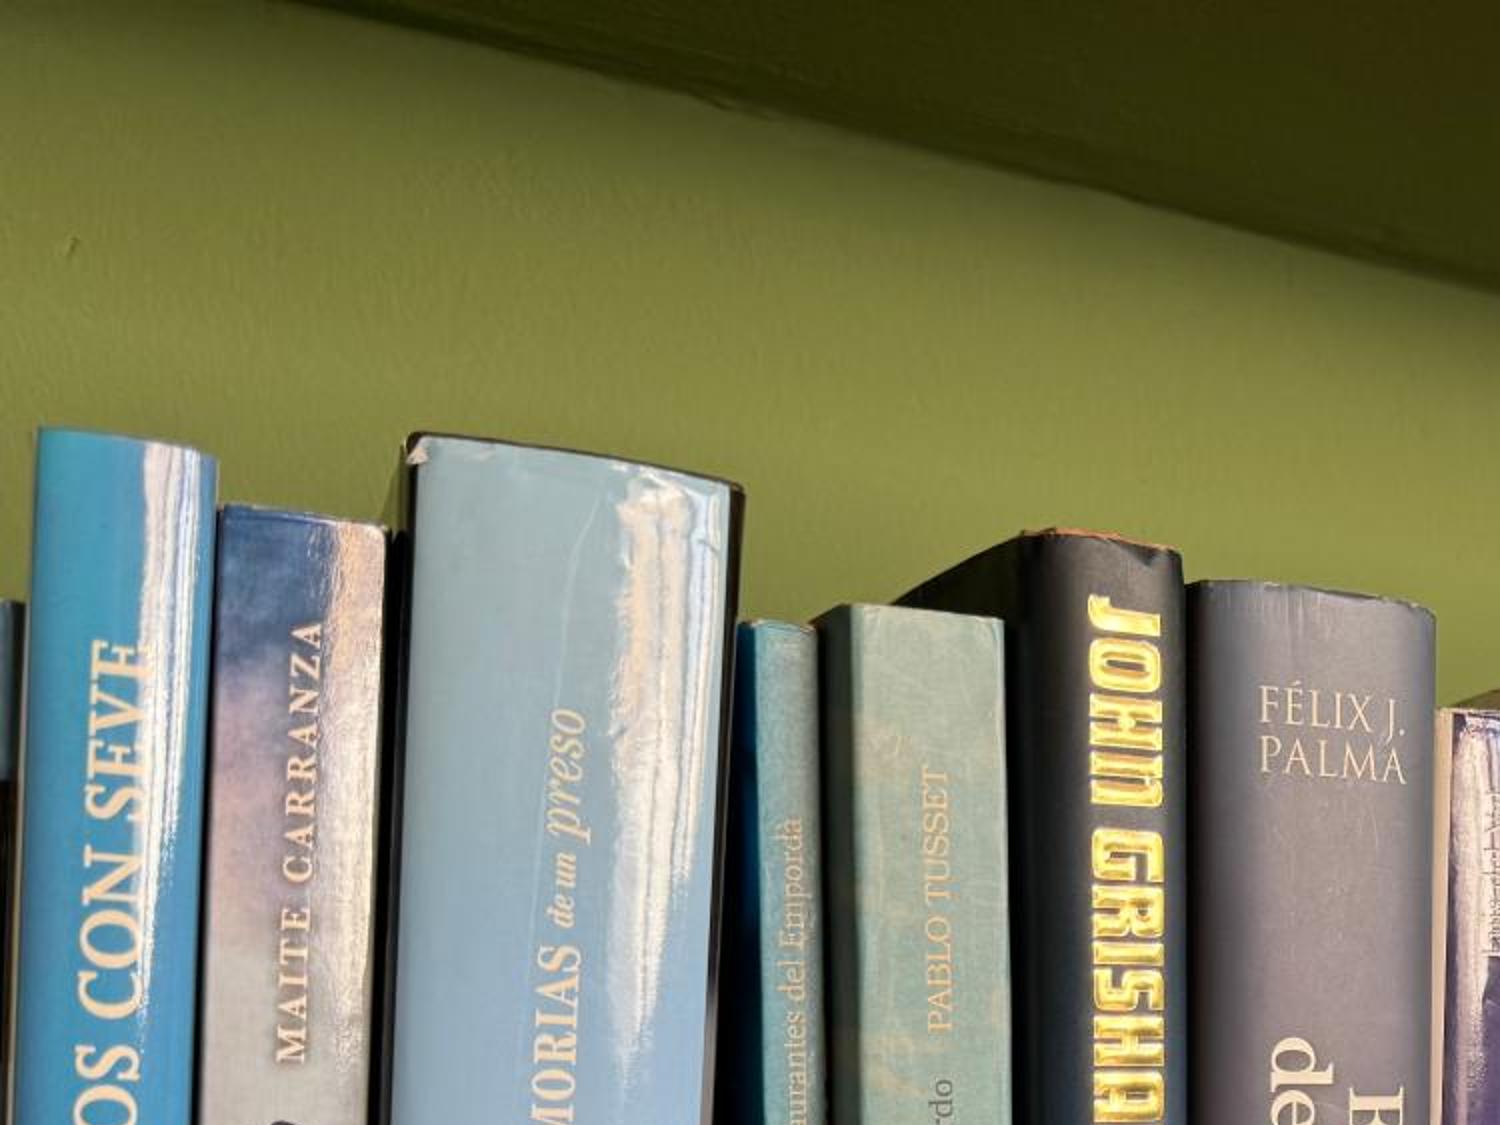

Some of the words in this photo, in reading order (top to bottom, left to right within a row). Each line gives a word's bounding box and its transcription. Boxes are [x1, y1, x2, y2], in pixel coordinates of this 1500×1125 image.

[84, 639, 153, 822] SEVE
[281, 621, 325, 883] CARRANZA
[1088, 593, 1164, 808] JOHN
[1258, 682, 1378, 731] FÉLIX
[1386, 698, 1406, 743] J.
[1258, 735, 1407, 785] PALMA
[547, 709, 591, 848] preso
[922, 767, 951, 902] TUSSET
[76, 844, 146, 1020] CON
[545, 893, 574, 929] de
[555, 852, 577, 886] un
[776, 816, 803, 947] Empordà
[276, 908, 311, 1063] MAITE
[779, 961, 805, 1001] del
[926, 918, 953, 1034] PABLO
